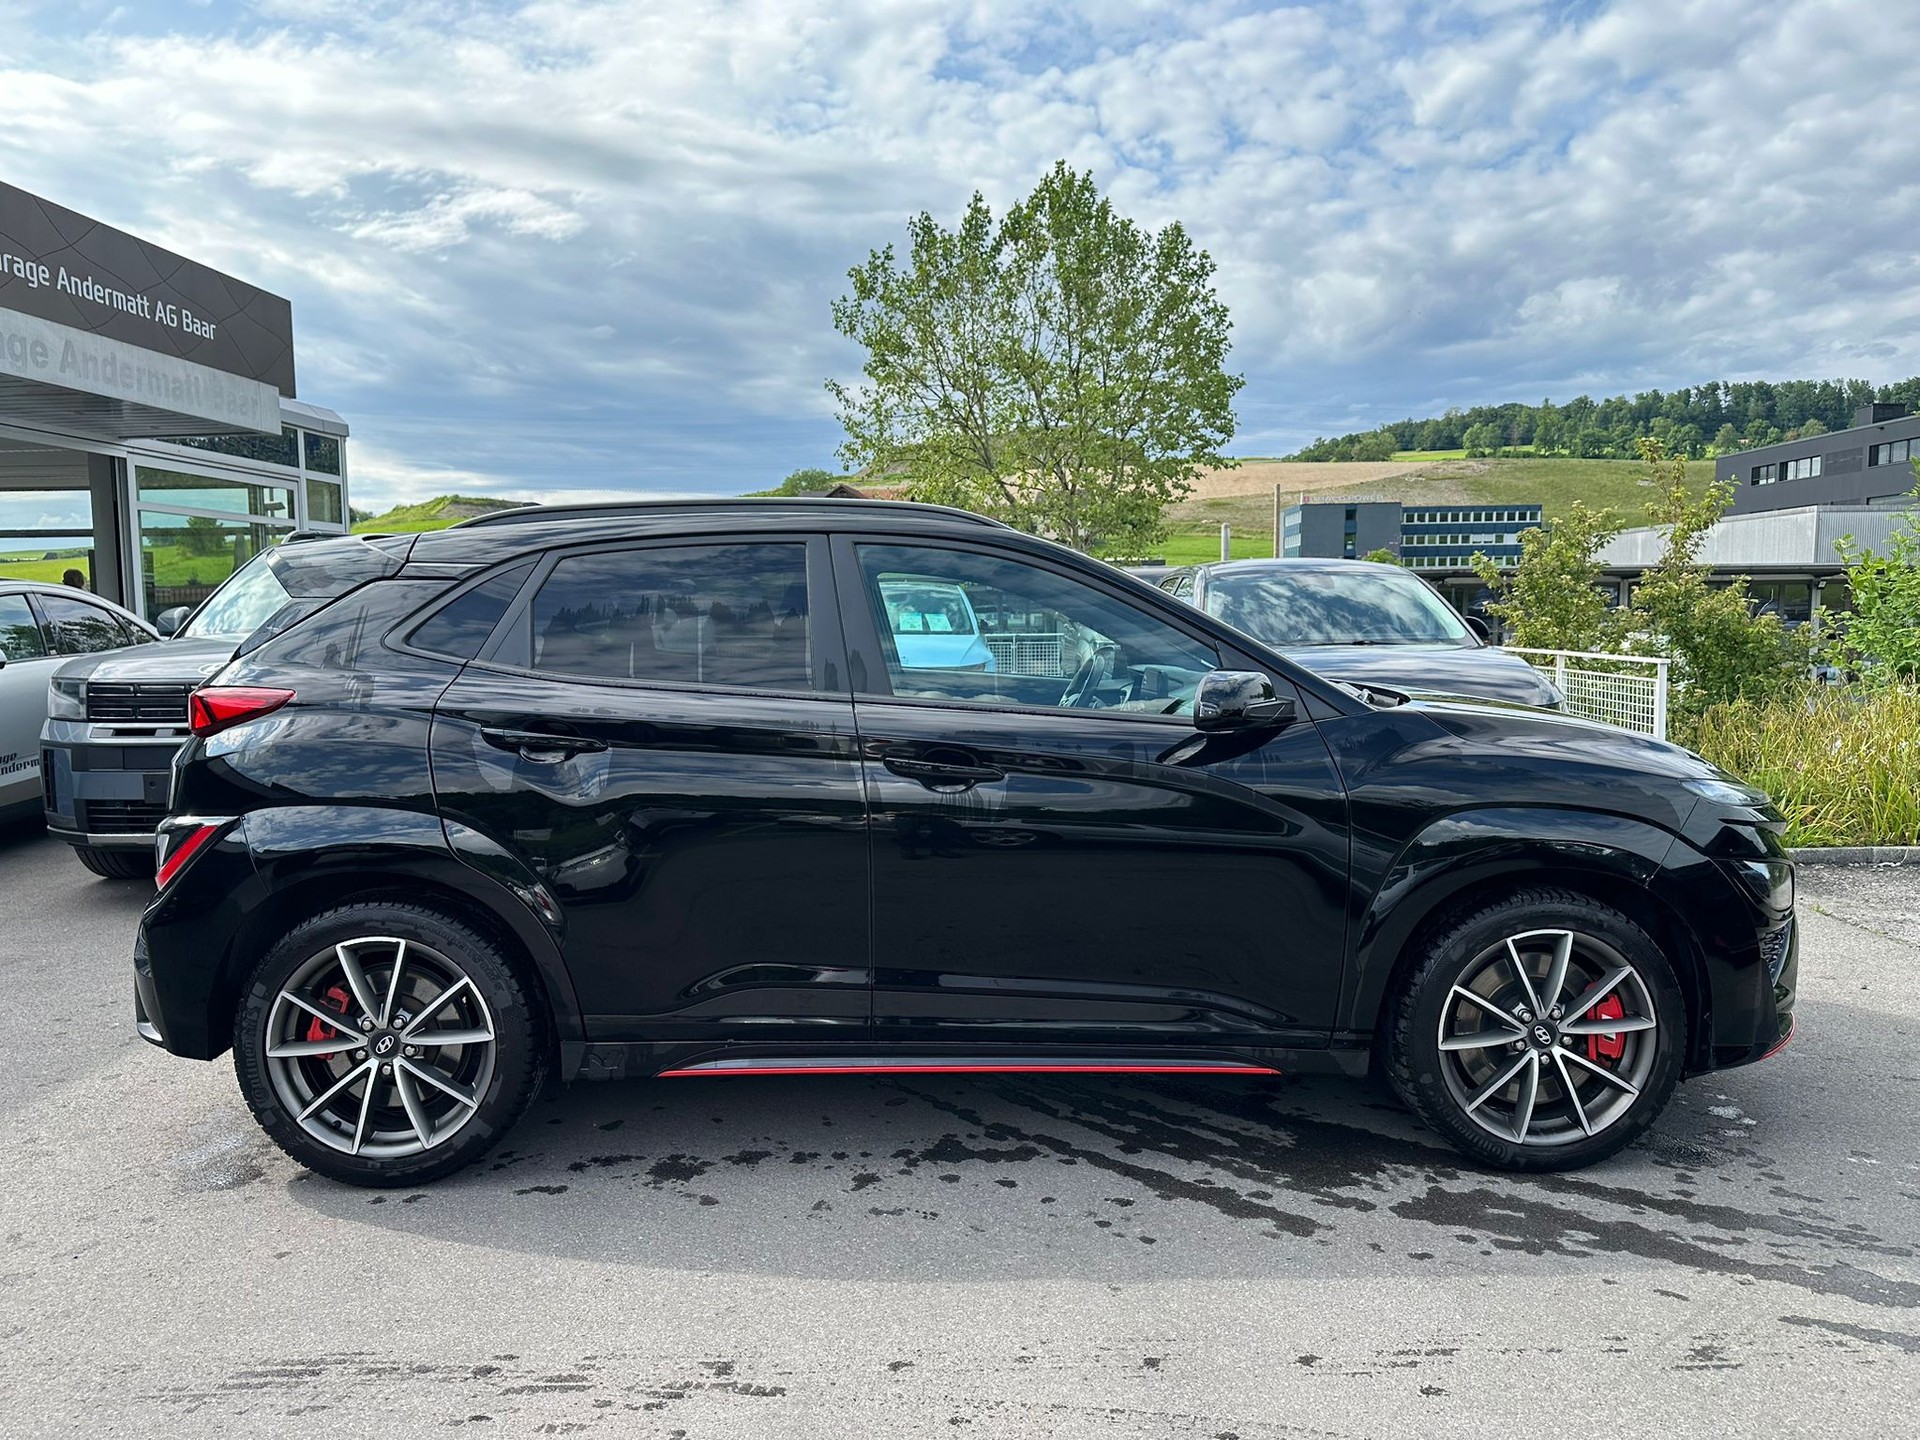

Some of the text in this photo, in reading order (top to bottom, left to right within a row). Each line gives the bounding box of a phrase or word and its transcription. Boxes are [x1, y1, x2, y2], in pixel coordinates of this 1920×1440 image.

[0, 253, 217, 340] rage Andermatt AG Baar
[0, 331, 49, 374] ge
[0, 752, 18, 765] ge
[0, 758, 40, 776] nderm
